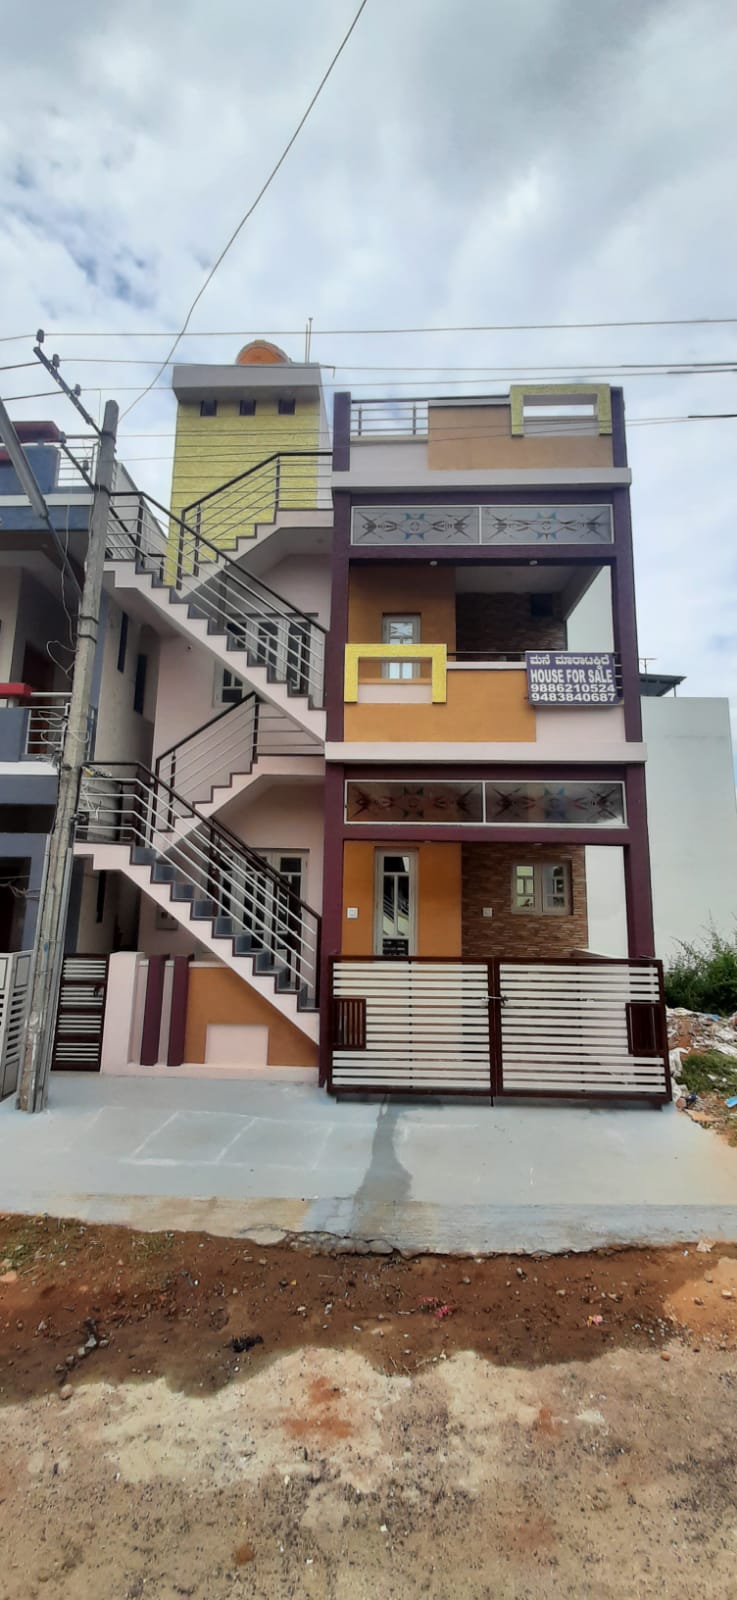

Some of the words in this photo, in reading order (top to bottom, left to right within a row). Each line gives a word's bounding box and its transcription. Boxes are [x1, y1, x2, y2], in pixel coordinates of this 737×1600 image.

[530, 669, 565, 683] HOUSE
[566, 669, 587, 683] FOR
[588, 669, 613, 683] SALE
[530, 683, 616, 693] 9886210524
[531, 693, 616, 702] 9483840687
